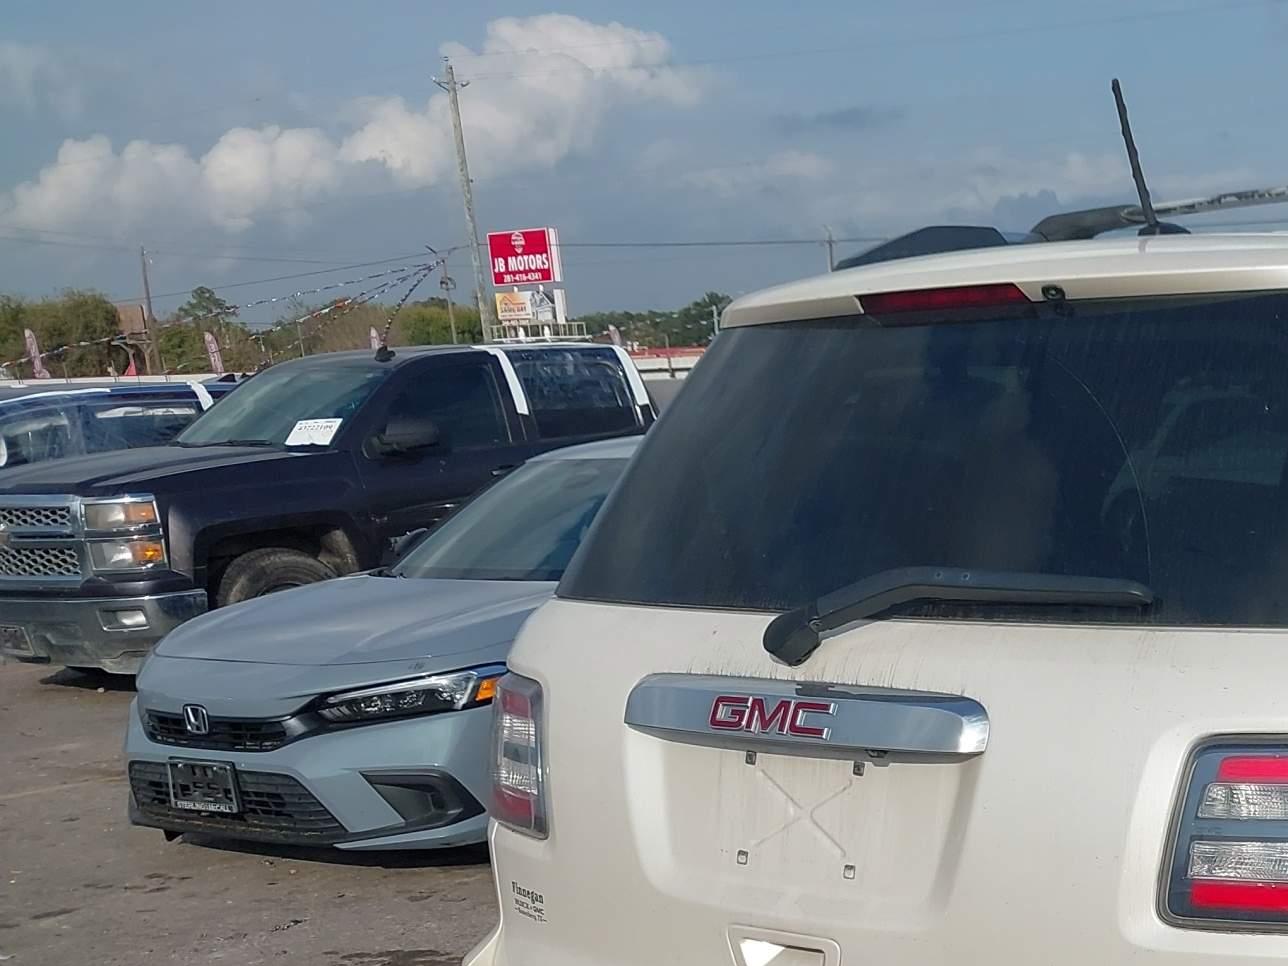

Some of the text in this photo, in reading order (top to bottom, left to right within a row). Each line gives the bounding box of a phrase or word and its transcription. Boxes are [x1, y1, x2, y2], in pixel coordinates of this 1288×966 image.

[494, 253, 549, 272] JB MOTORS
[709, 695, 838, 740] GMC
[511, 880, 544, 904] Finnegan
